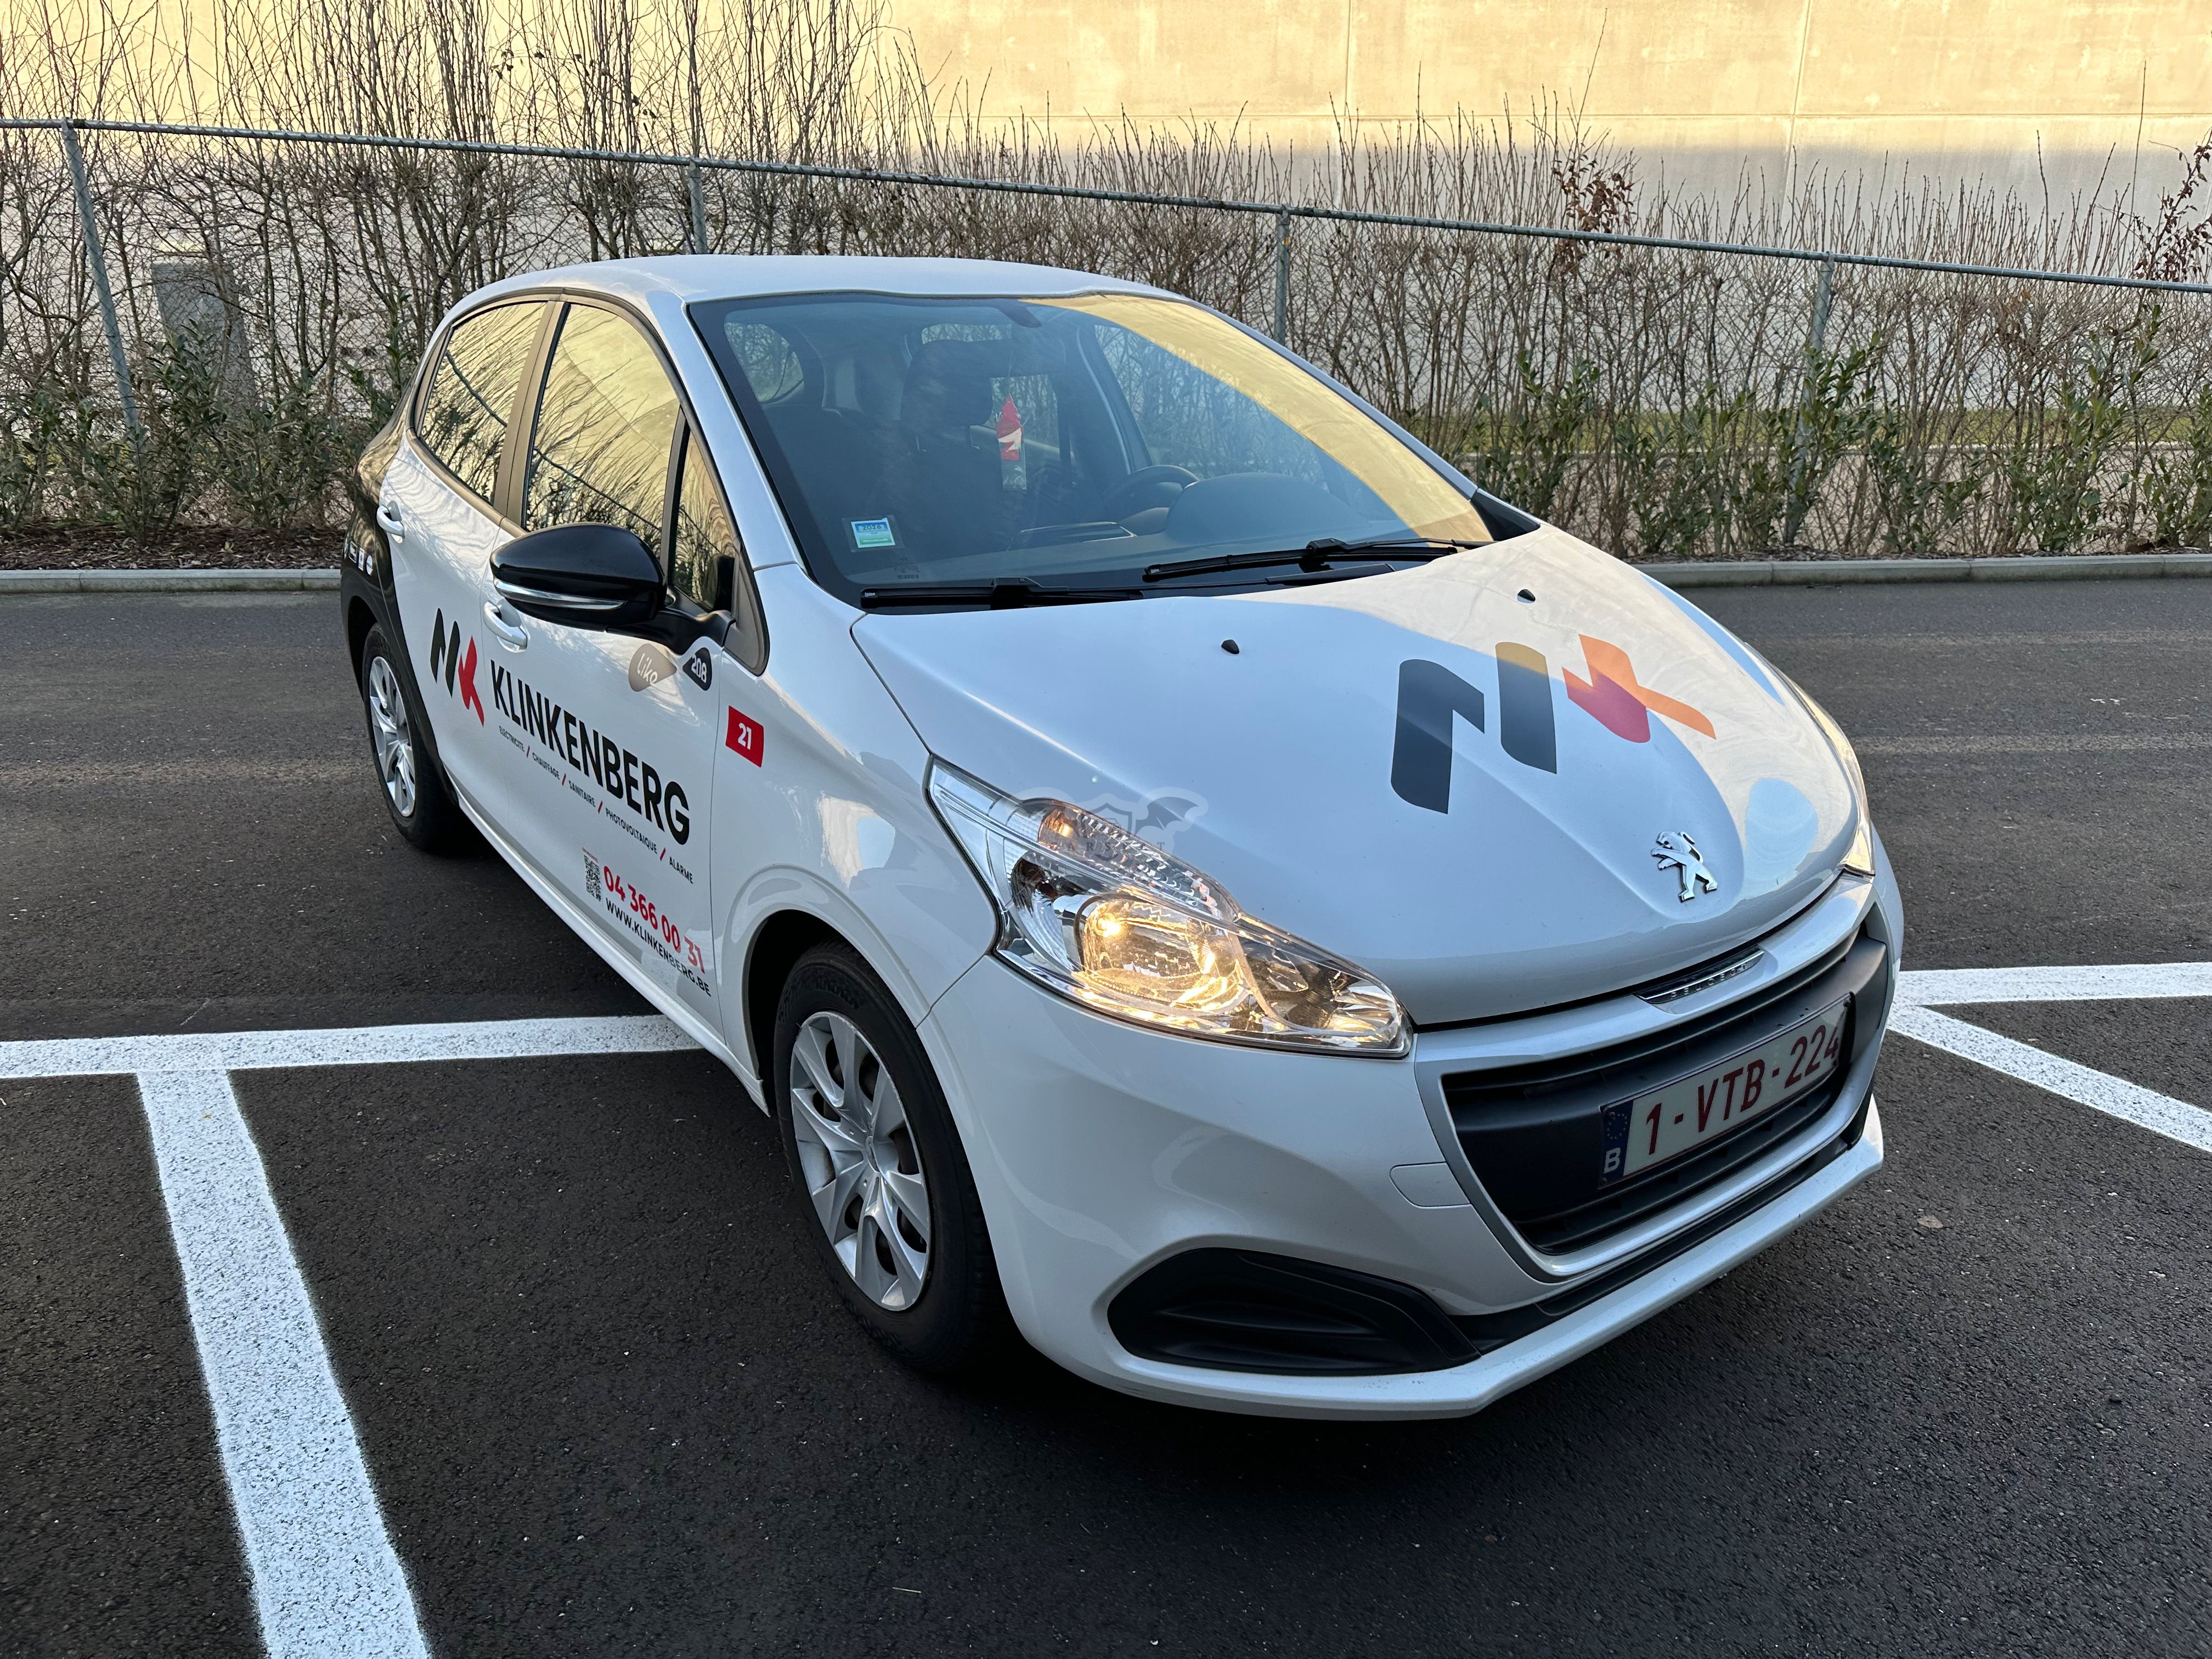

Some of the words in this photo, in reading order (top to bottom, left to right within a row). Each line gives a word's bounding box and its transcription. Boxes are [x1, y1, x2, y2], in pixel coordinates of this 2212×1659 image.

[691, 656, 708, 684] 208
[490, 659, 690, 845] KLINKENBERG
[737, 722, 752, 750] 21
[532, 752, 560, 781] CHAUFFAGE
[568, 779, 596, 808] SANITAIRE
[605, 806, 658, 854] PHOTOVOLTAIQUE
[669, 856, 693, 884] ALARME
[603, 865, 625, 901] 04
[628, 883, 658, 930] 366
[661, 914, 681, 953] 00
[684, 935, 706, 974] 31
[606, 897, 712, 997] WWW.KLINKENBERG.BE
[1603, 1147, 1622, 1175] B
